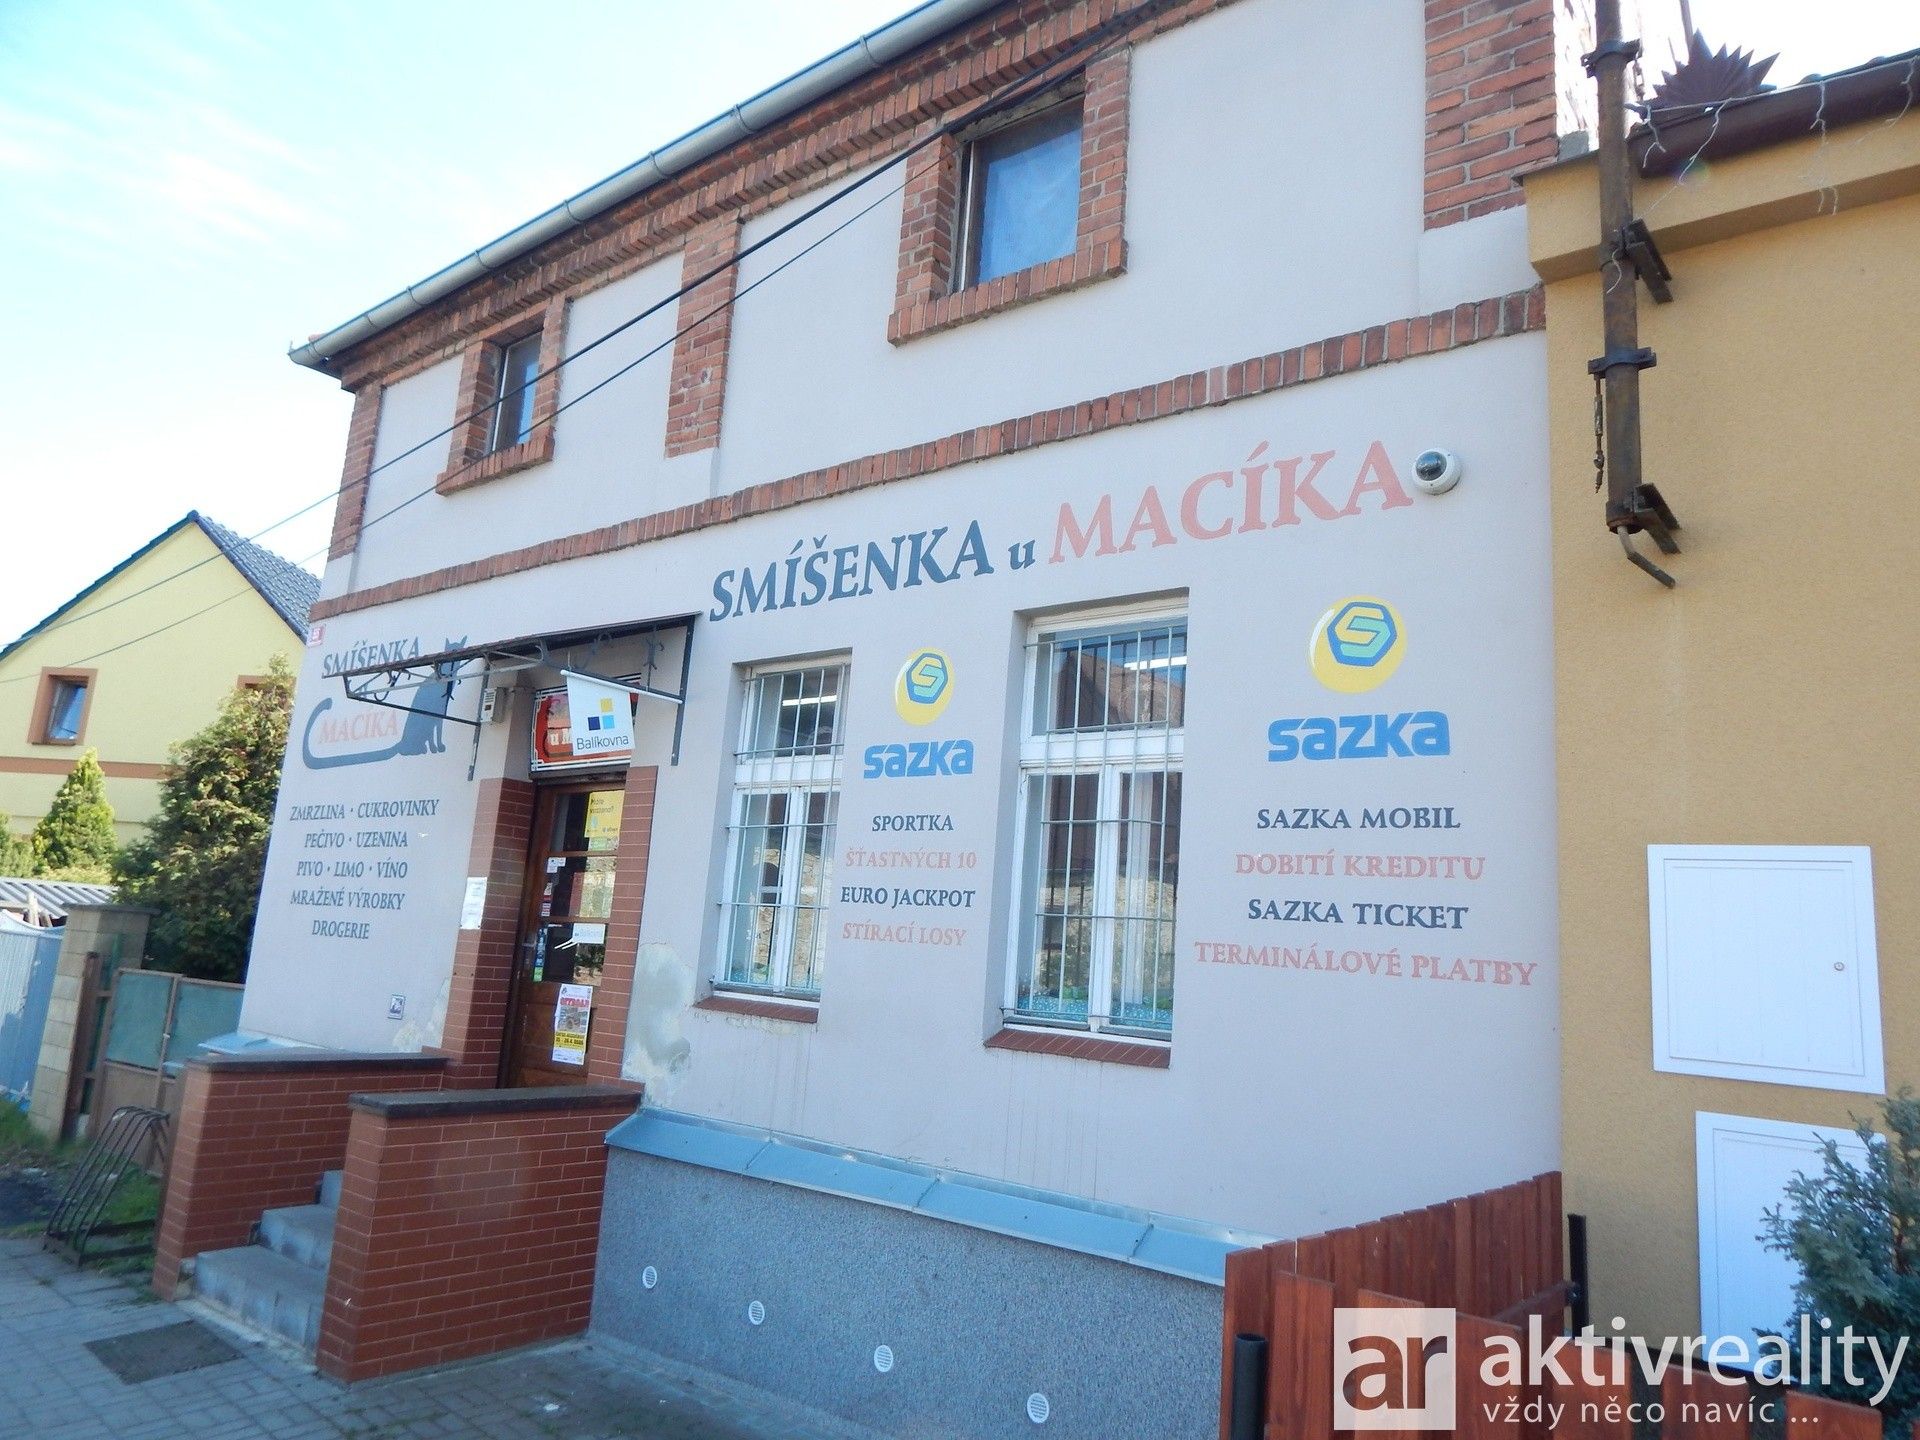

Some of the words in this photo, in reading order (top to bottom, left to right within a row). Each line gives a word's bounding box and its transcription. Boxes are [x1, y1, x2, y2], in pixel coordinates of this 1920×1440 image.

[710, 519, 995, 621] SMÍŠENKA
[1008, 539, 1036, 570] u
[1049, 440, 1414, 564] MACÍKA
[319, 705, 398, 743] MACÍKA
[576, 735, 629, 750] Balíkovna
[290, 804, 345, 821] ZMRZLINA
[357, 799, 440, 818] CUKROVINKY
[1257, 808, 1352, 829] SAZKA
[1360, 807, 1461, 829] MOBIL
[872, 814, 954, 832] SPORTKA
[304, 829, 345, 848] PEČIVO
[356, 831, 408, 848] UZENINA
[296, 861, 323, 876] PIVO
[333, 861, 364, 877] LIMO
[377, 857, 408, 879] VÍNO
[845, 847, 951, 869] ŠŤASTNÝCH
[957, 851, 977, 869] 10
[1235, 848, 1335, 876] DOBITÍ
[1344, 854, 1486, 880] KREDITU
[290, 886, 345, 906] MRAŽENÉ
[348, 887, 405, 910] VÝROBKY
[840, 887, 888, 904] EURO
[892, 888, 976, 908] JACKPOT
[1248, 898, 1344, 923] SAZKA
[1352, 902, 1469, 929] TICKET
[312, 920, 370, 939] DROGERIE
[842, 919, 916, 944] STÍRACÍ
[919, 926, 968, 946] LOSY
[1194, 940, 1403, 977] TERMINÁLOVÉ
[1410, 953, 1538, 986] PLATBY
